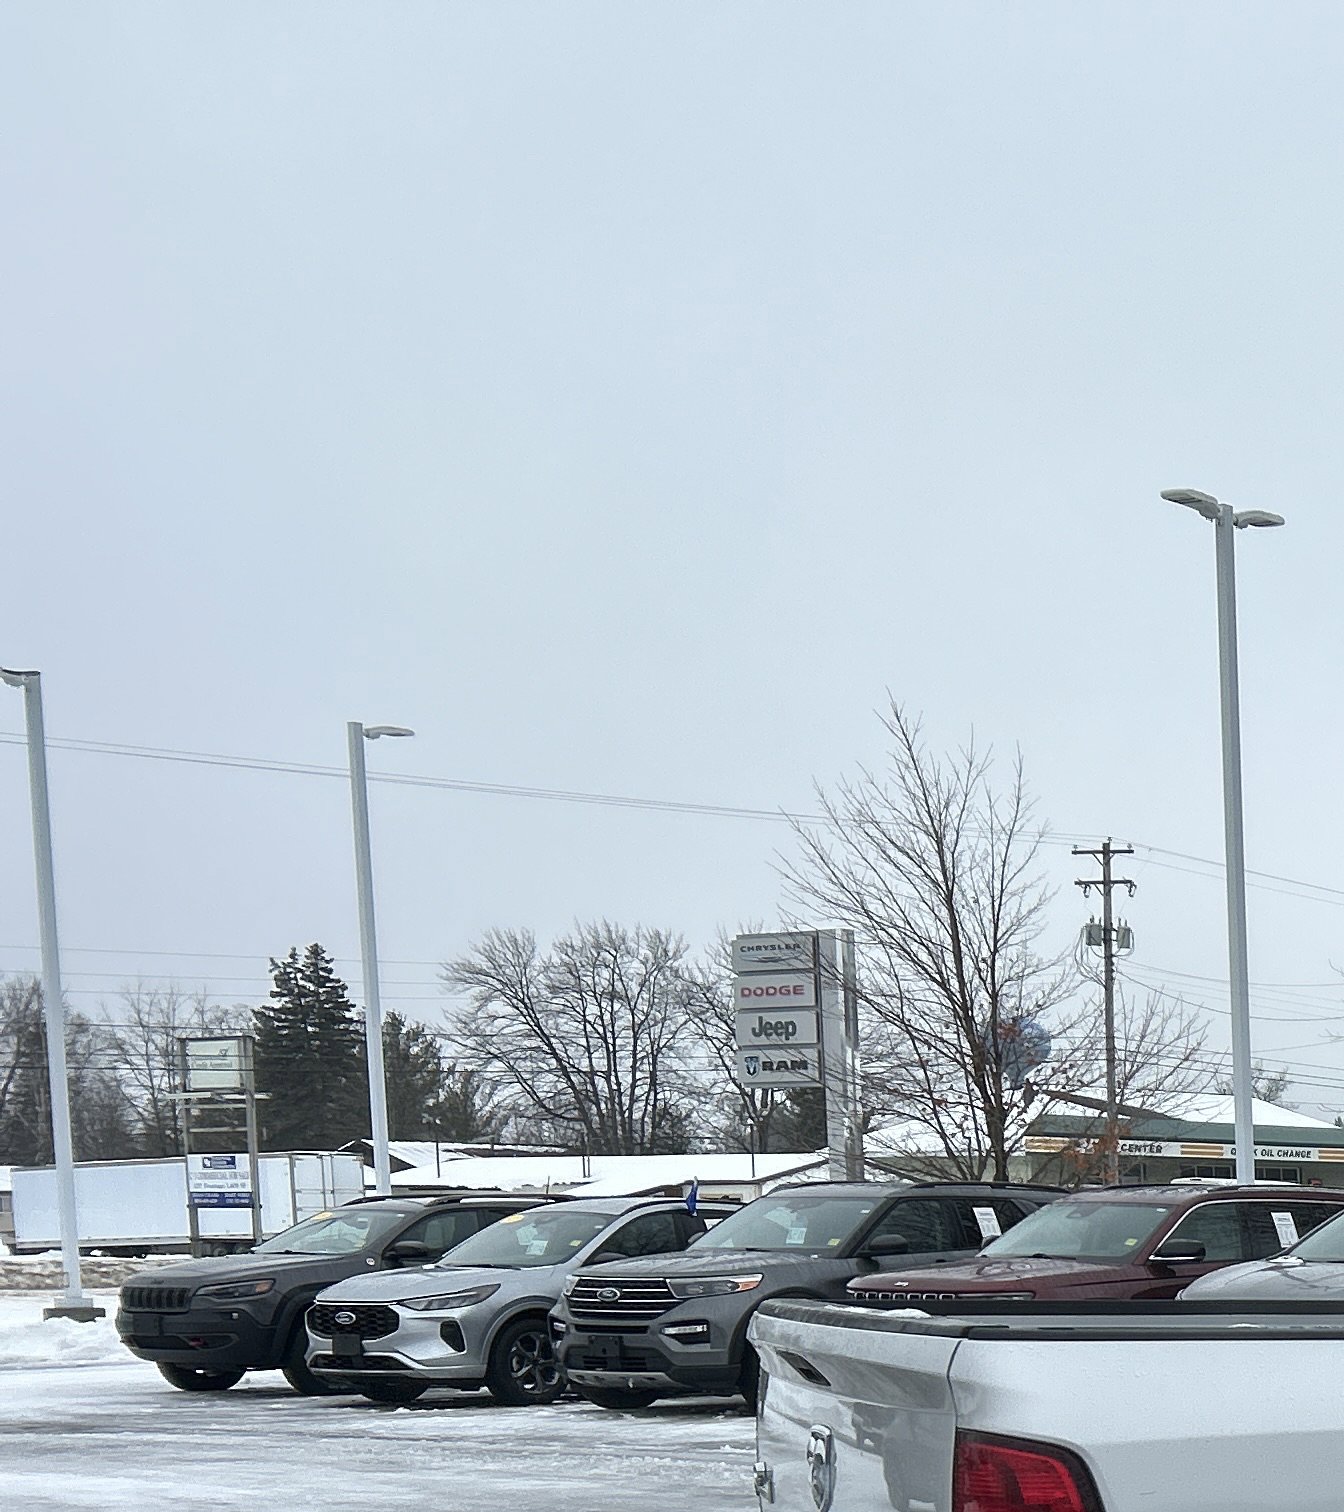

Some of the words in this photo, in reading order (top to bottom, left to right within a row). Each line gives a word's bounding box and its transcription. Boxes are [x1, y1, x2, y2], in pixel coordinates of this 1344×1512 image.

[740, 944, 800, 952] CHRYSLER
[740, 985, 805, 997] DODGE
[751, 1016, 797, 1040] Jeep
[762, 1060, 808, 1071] RAM
[1120, 1143, 1163, 1154] CENTER
[1260, 1149, 1275, 1157] OIL
[1277, 1149, 1312, 1158] CHANGE
